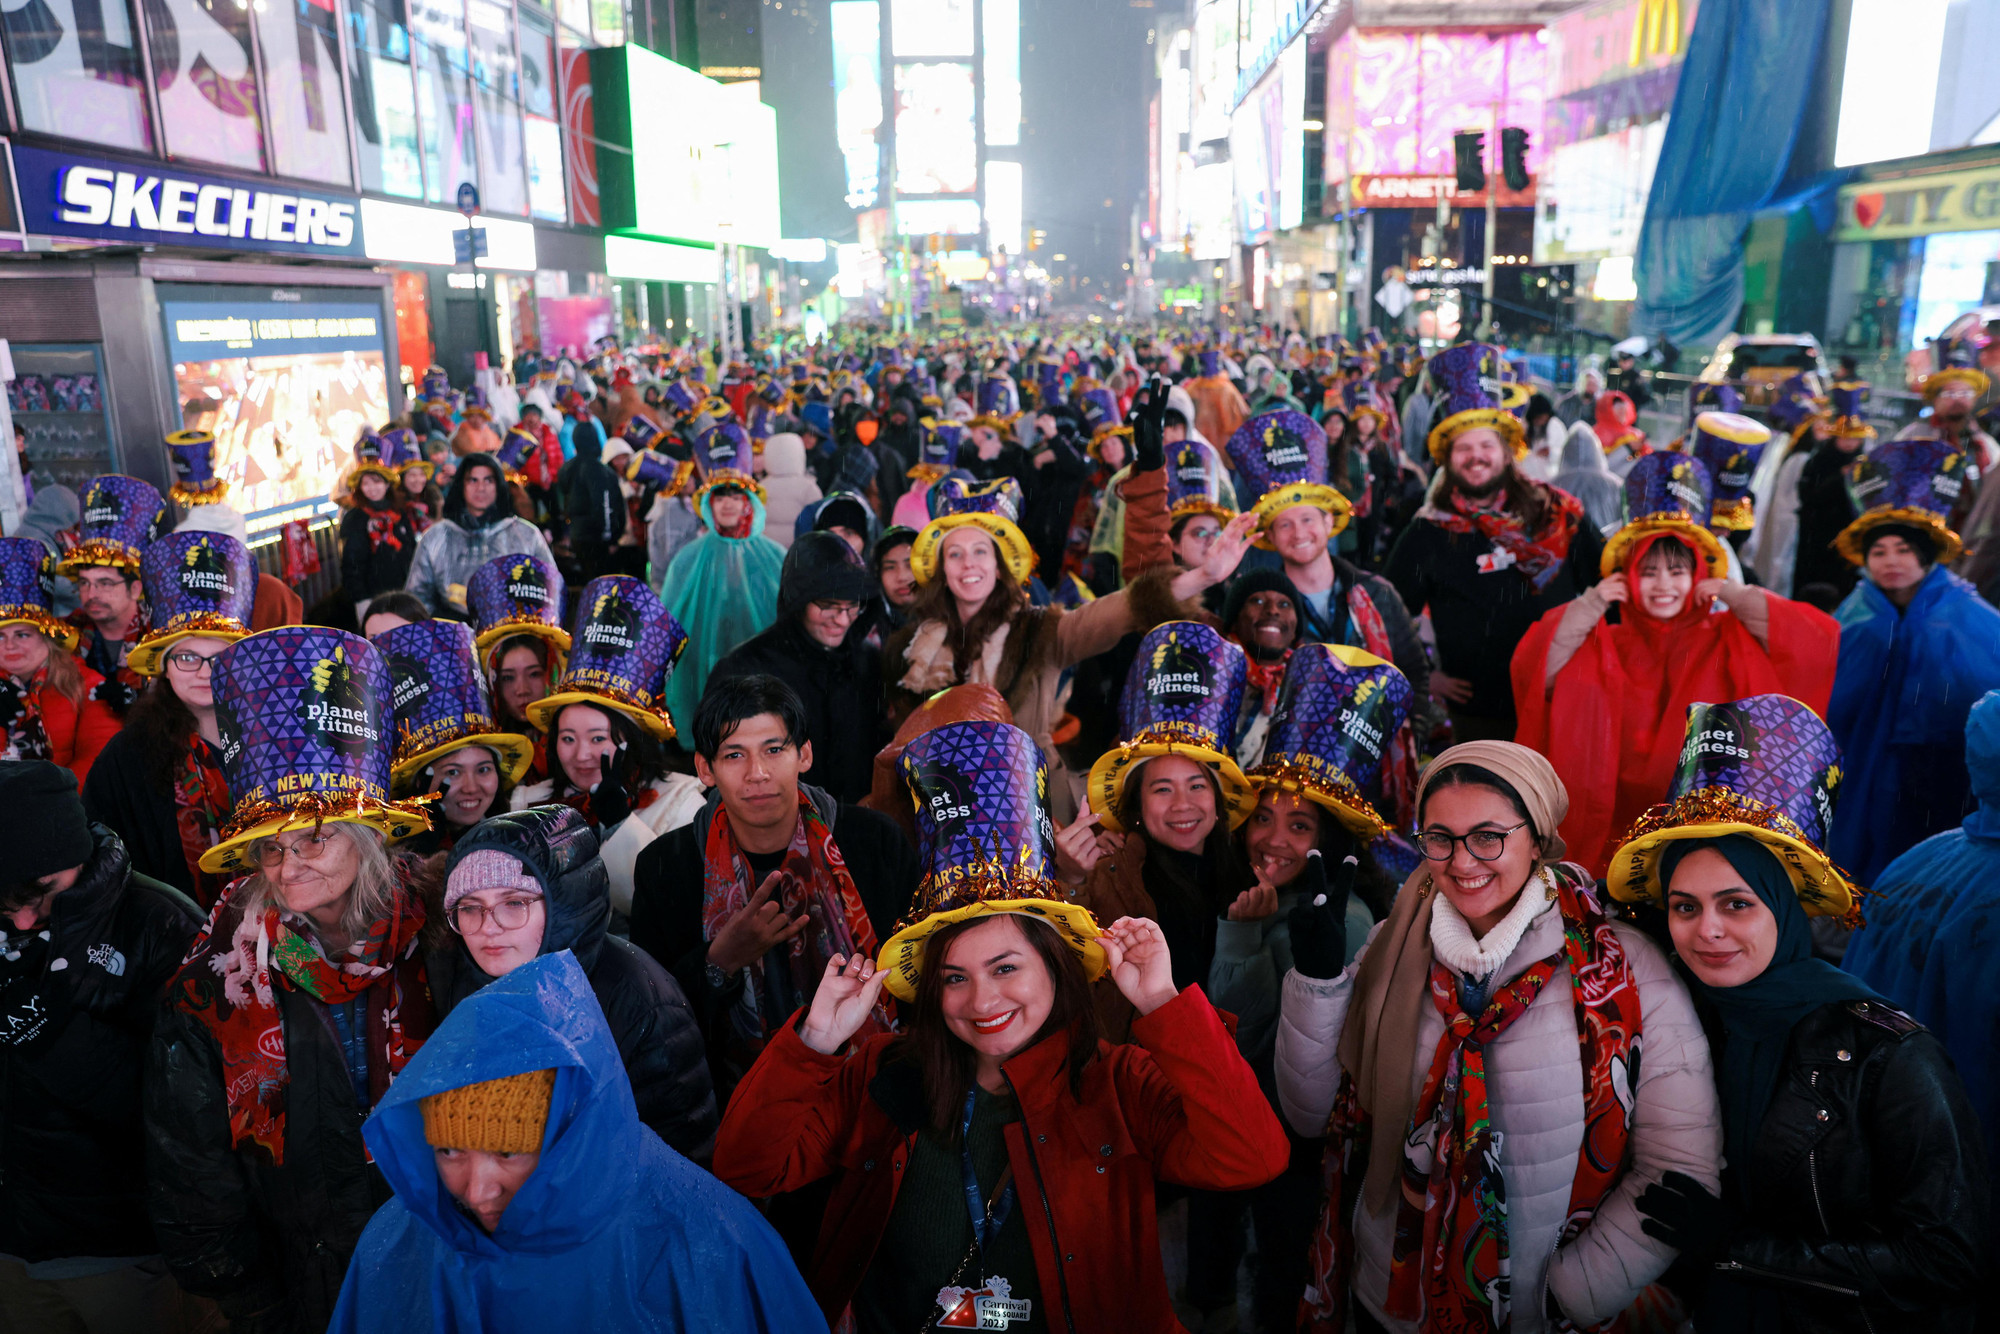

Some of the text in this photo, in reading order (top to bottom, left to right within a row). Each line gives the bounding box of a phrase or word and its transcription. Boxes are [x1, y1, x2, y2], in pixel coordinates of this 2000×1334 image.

[63, 165, 355, 247] SKECHERS
[182, 570, 228, 583] planet
[188, 578, 235, 595] fitness
[509, 582, 548, 595] planet
[584, 622, 628, 637] planet
[586, 632, 634, 649] fitness
[393, 675, 416, 698] net
[577, 668, 612, 683] YEAR'S
[612, 674, 633, 690] EVE
[1147, 671, 1200, 691] planet
[1152, 681, 1210, 696] fitness
[308, 701, 369, 723] planet
[317, 716, 378, 741] fitness
[433, 715, 457, 732] EVE
[464, 712, 485, 724] NEW
[1338, 708, 1384, 744] planet
[1153, 720, 1196, 734] YEAR'S
[1198, 726, 1219, 744] EVE
[1342, 724, 1382, 760] fitness
[1294, 752, 1325, 770] NEW
[1325, 761, 1357, 792] YEAR'S
[277, 772, 386, 802] NEW YEAR'S EVE
[87, 944, 111, 960] ORT
[88, 956, 109, 967] FAC
[27, 1018, 48, 1035] SQUARE
[982, 1299, 1028, 1311] Carnival
[982, 1309, 1028, 1319] TIMES SQUARE
[982, 1317, 1005, 1329] 2023
